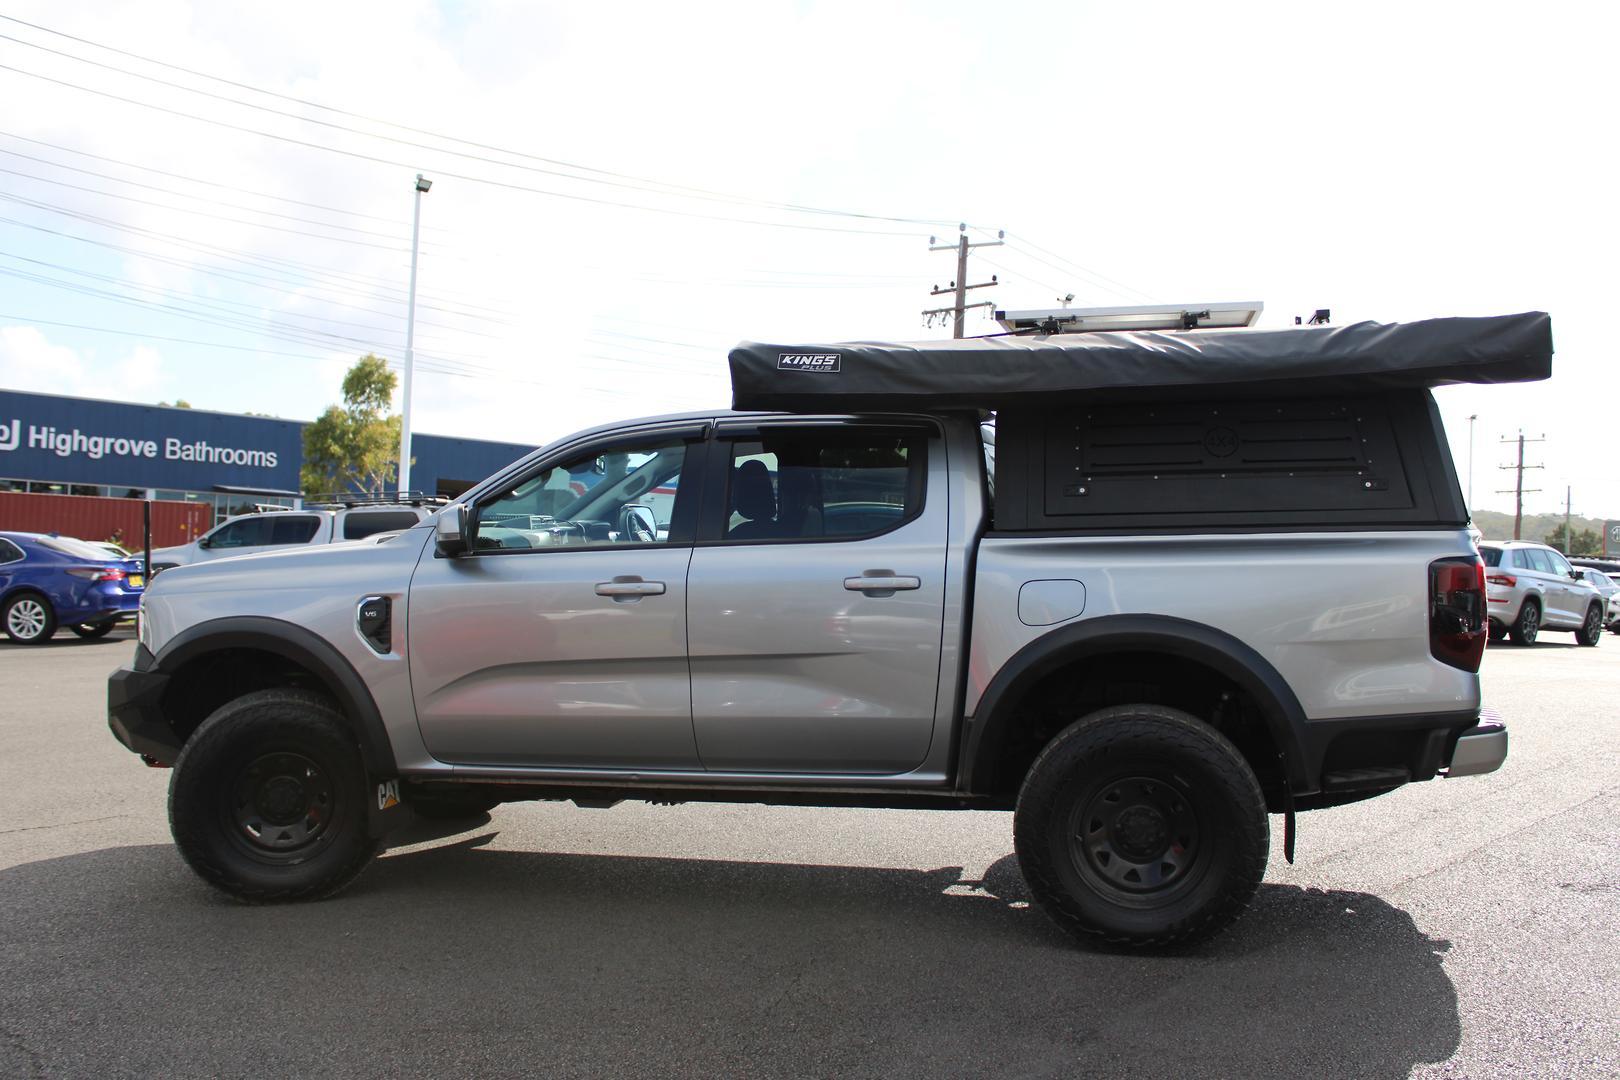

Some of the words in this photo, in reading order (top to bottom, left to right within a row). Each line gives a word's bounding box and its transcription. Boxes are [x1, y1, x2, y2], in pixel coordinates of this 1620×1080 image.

[782, 355, 837, 365] KINGS
[28, 425, 157, 460] Highgrove
[165, 438, 278, 468] Bathrooms
[377, 778, 401, 811] CAT
